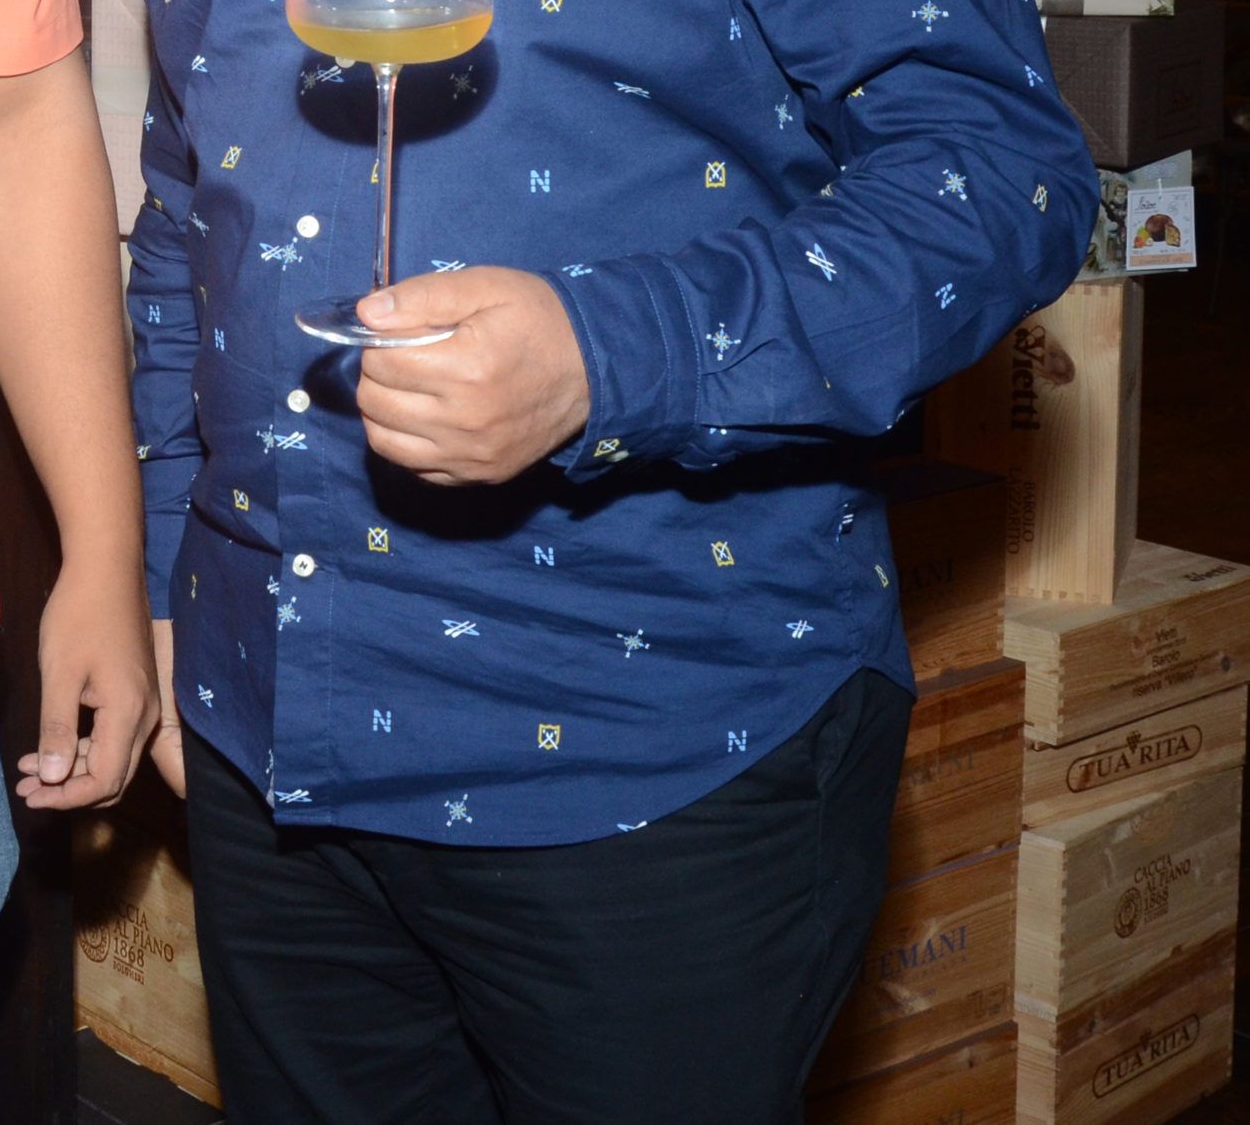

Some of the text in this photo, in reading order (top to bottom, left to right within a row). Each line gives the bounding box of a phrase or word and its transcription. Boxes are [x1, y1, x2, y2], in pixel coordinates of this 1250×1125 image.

[1079, 734, 1191, 781] TUA RITA
[1134, 855, 1171, 884] CACCIA
[1158, 858, 1191, 887] PIANO
[1144, 886, 1170, 911] 1868
[113, 919, 129, 940] AL
[133, 925, 175, 963] PIANO
[113, 937, 145, 968] 1868
[1102, 1026, 1191, 1086] TUA RITA
